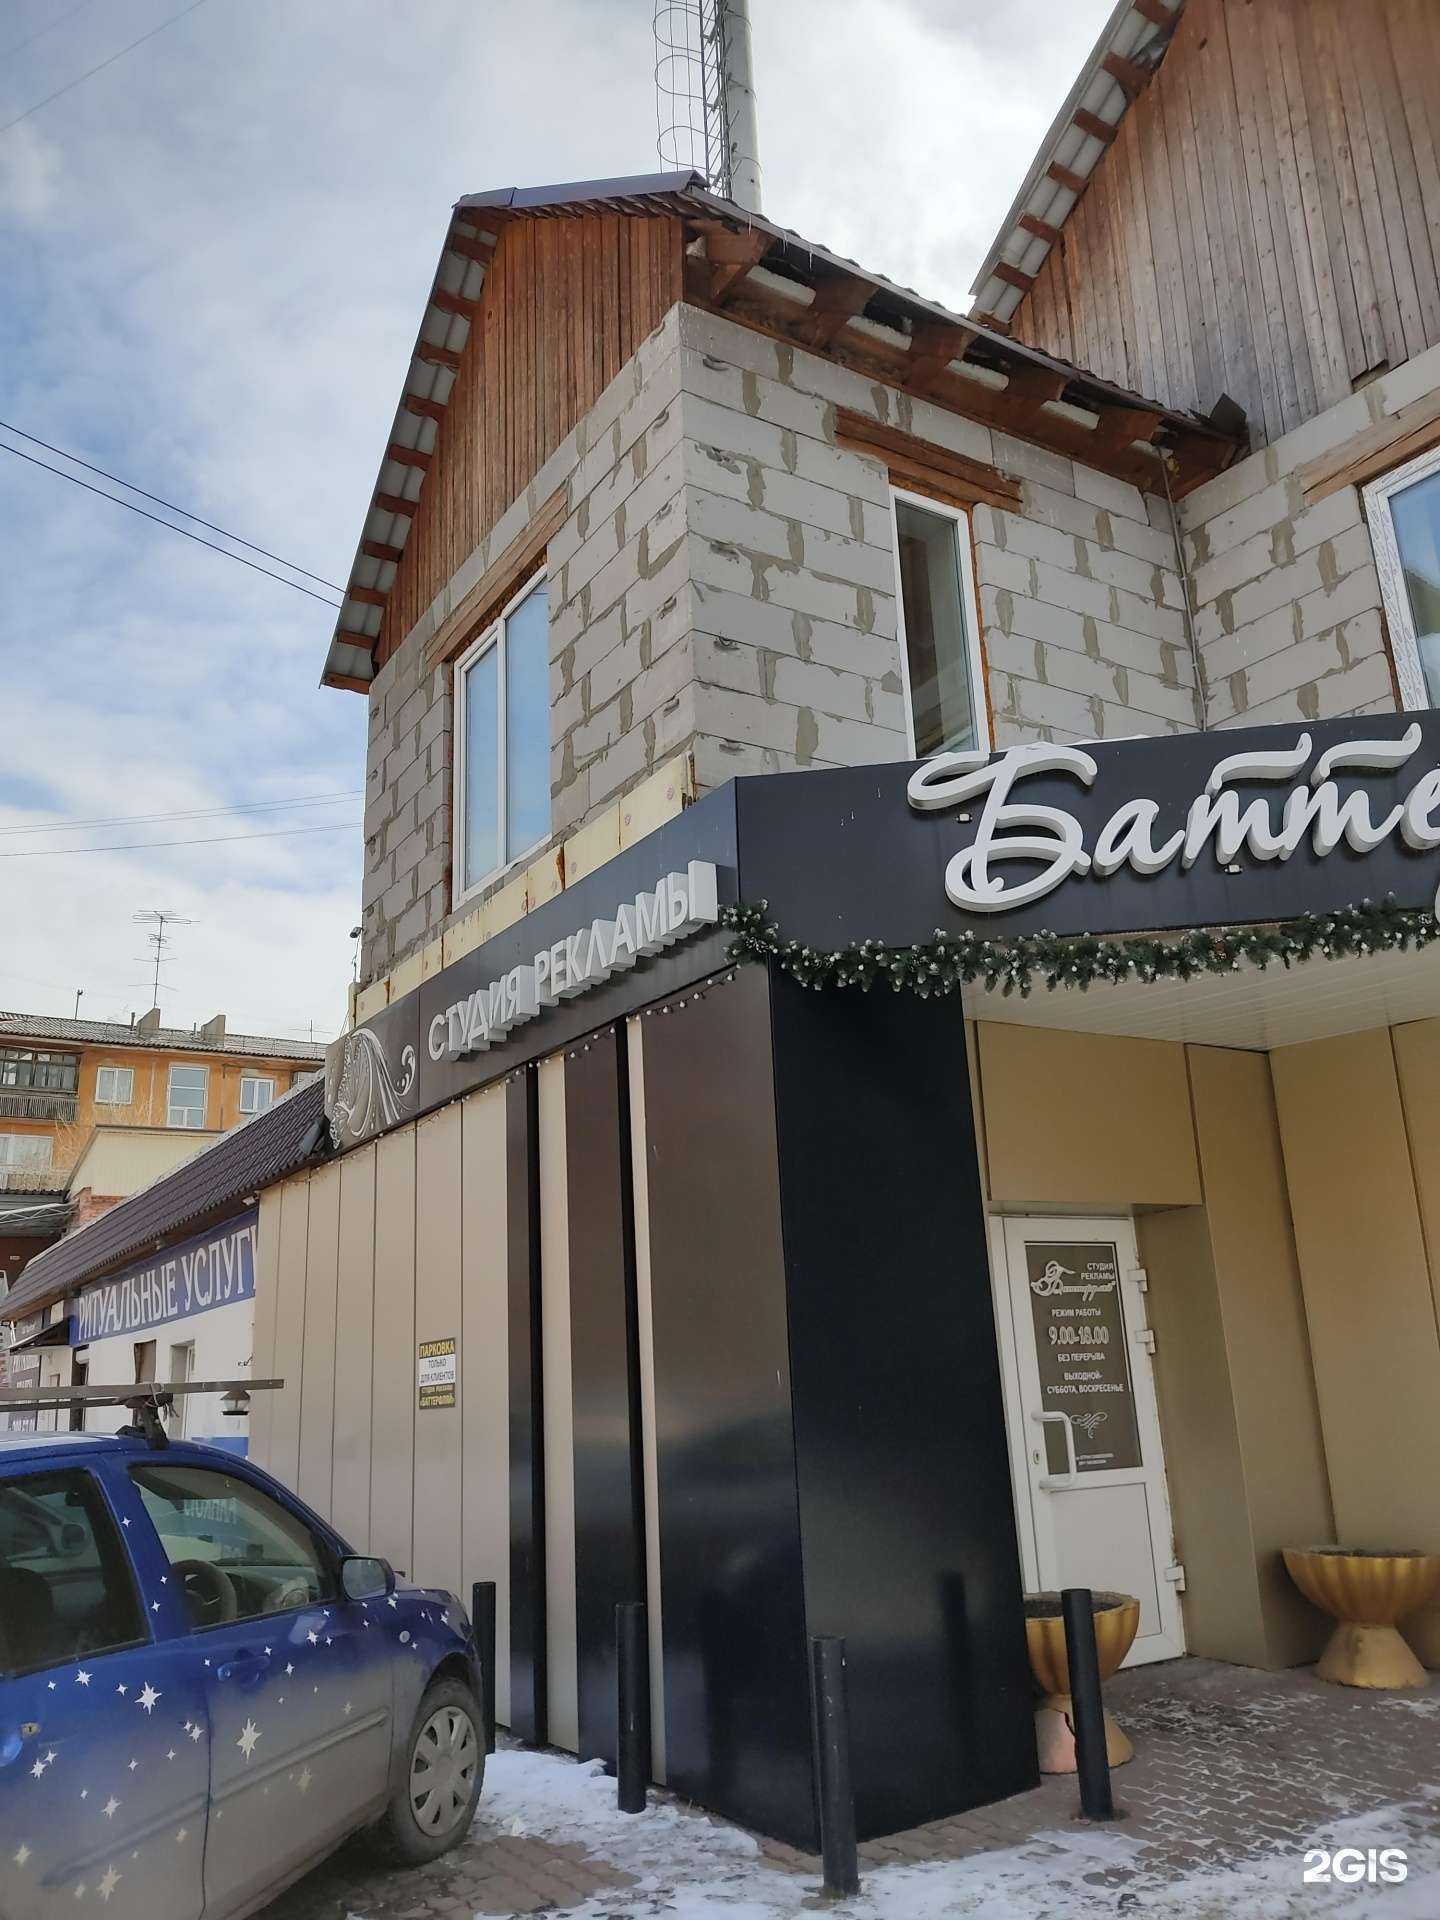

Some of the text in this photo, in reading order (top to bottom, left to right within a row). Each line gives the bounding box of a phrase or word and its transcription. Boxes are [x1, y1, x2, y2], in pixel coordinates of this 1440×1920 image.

[907, 722, 1440, 925] Батте
[428, 859, 719, 1062] СТУДИЯ РЕКЛАМЫ
[1087, 1262, 1114, 1271] СТУДИЯ
[1080, 1272, 1115, 1280] РЕКЛАМЫ
[78, 1260, 178, 1341] РИТУАЛЬНЫЕ
[1051, 1308, 1102, 1317] РЕЖИМ РАБОТЫ
[1048, 1326, 1110, 1345] 9.00-18.00
[420, 1340, 455, 1358] ПАРКОВКА
[1057, 1352, 1106, 1362] БЕЗ ПЕРЕРЫВА
[1079, 1383, 1124, 1393] ВОСКРЕСЕНЬЕ
